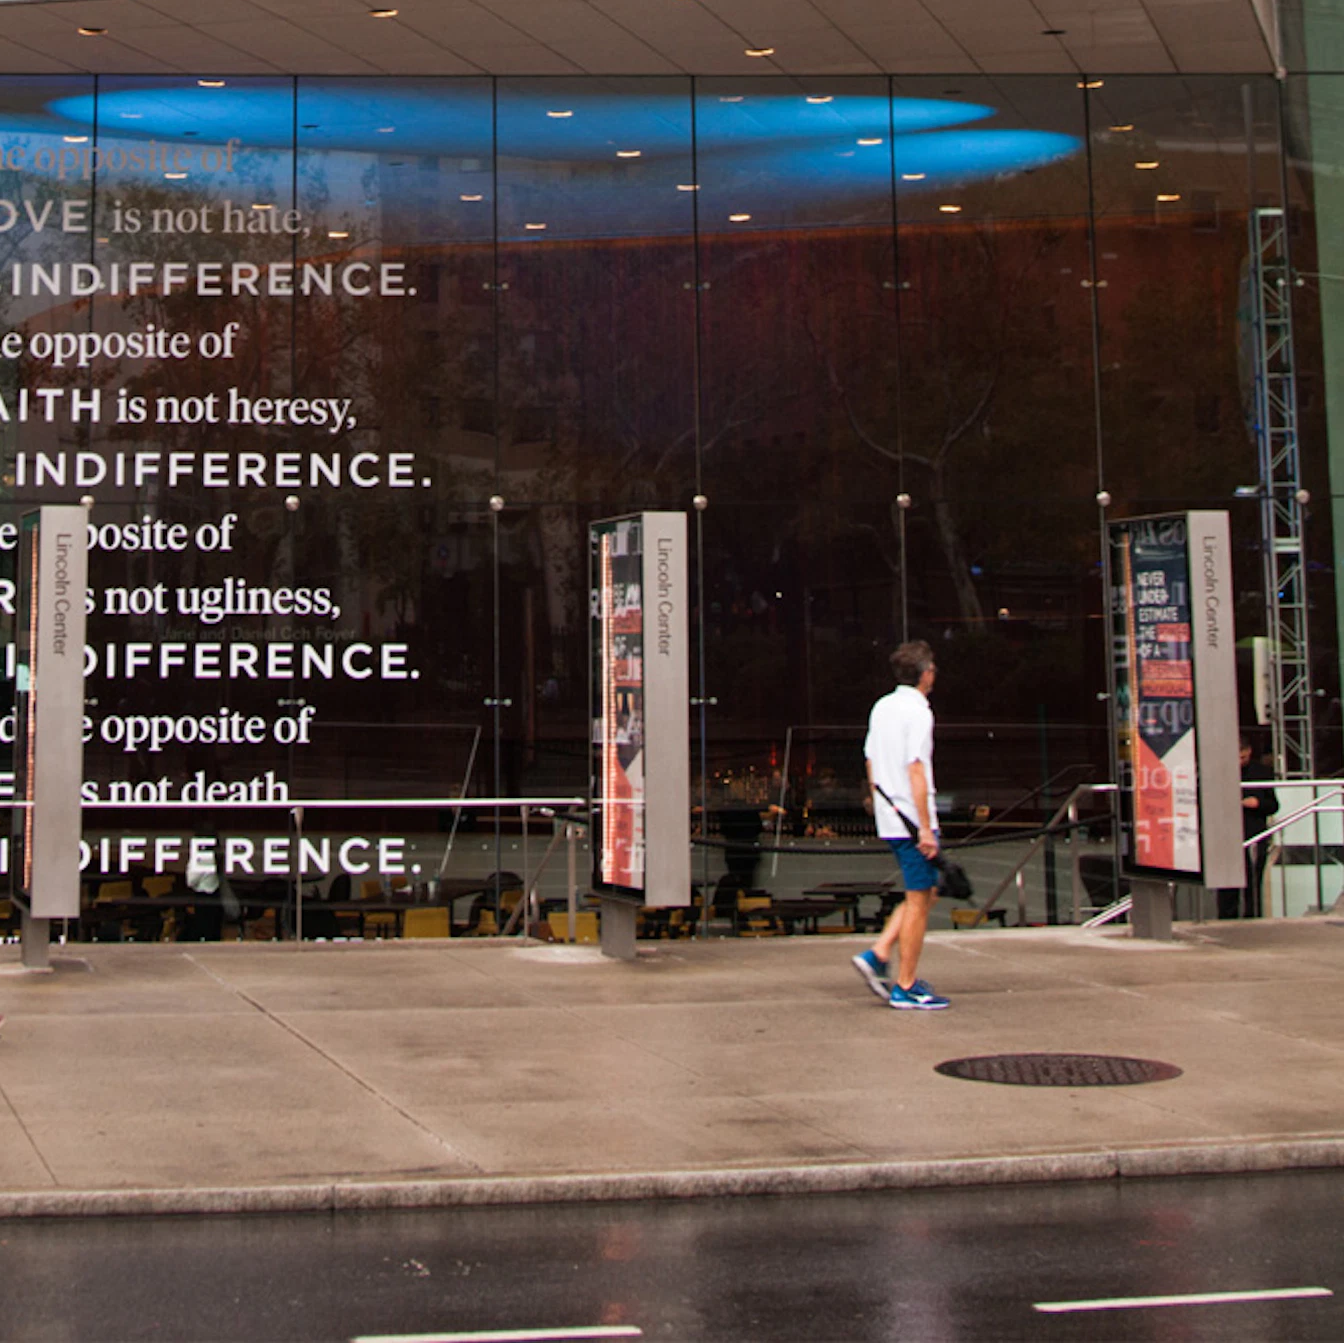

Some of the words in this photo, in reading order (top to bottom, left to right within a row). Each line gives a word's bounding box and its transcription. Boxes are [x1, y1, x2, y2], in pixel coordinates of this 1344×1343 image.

[32, 140, 191, 181] opposite
[198, 138, 241, 173] of
[113, 199, 141, 234] is
[152, 205, 212, 234] not
[222, 199, 311, 239] hate,
[12, 262, 418, 296] INDIFFERENCE.
[29, 323, 190, 367] opposite
[198, 322, 240, 359] of
[116, 387, 147, 424] is
[155, 394, 219, 424] not
[227, 386, 356, 433] heresy,
[15, 452, 433, 488] INDIFFERENCE.
[87, 514, 189, 551] posite
[195, 513, 238, 551] of
[54, 533, 72, 597] Lincoln
[657, 537, 672, 597] Lincoln
[1202, 536, 1218, 594] Lincoln
[105, 581, 169, 615] not
[176, 576, 342, 624] ugliness,
[1138, 606, 1179, 623] ESTIMATE
[52, 599, 71, 656] Center
[657, 600, 672, 656] Center
[1204, 596, 1220, 650] Center
[100, 707, 266, 751] opposite
[274, 706, 316, 743] of
[109, 774, 173, 803] not
